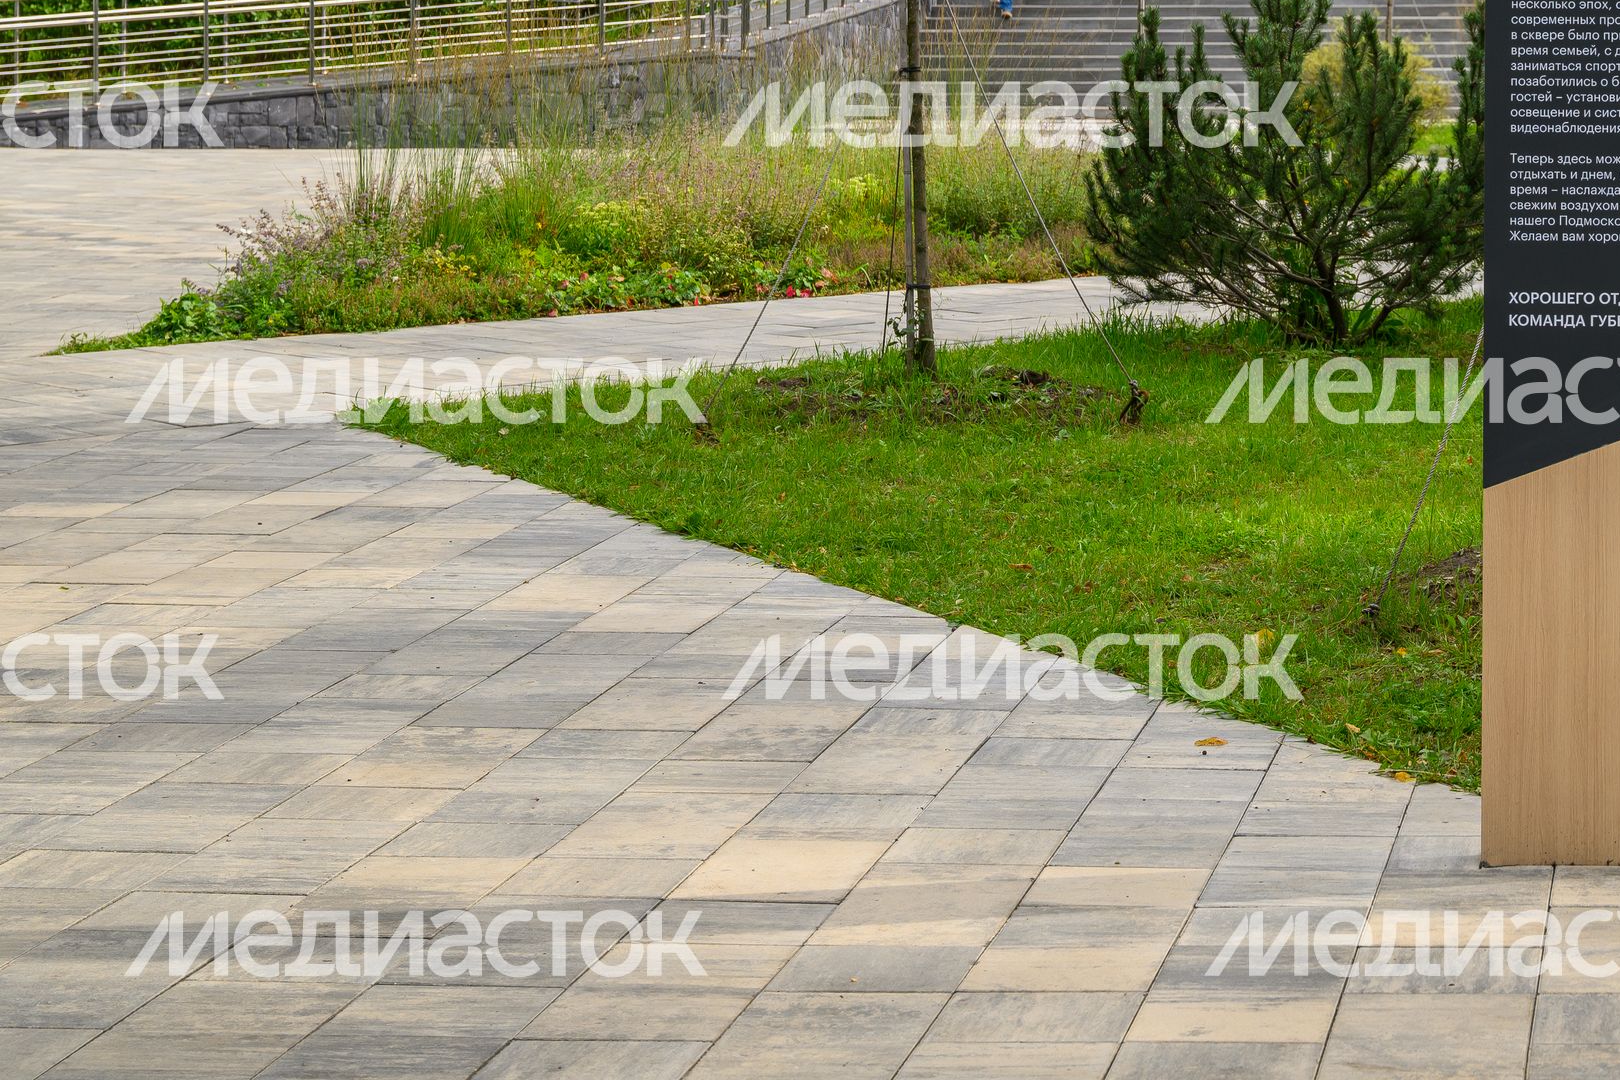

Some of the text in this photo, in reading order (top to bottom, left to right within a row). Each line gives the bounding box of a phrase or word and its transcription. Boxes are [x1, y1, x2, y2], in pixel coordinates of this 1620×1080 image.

[1511, 0, 1577, 10] несколько
[1578, 0, 1612, 12] эпох,
[1510, 15, 1596, 27] современных
[1510, 31, 1518, 40] в
[1520, 31, 1565, 43] сквере
[1567, 28, 1600, 41] было
[1510, 46, 1549, 58] время
[1551, 44, 1601, 57] семьей,
[1604, 47, 1613, 56] с
[1510, 62, 1582, 72] заниматься
[1510, 75, 1598, 87] позаботились
[1600, 78, 1609, 87] о
[1510, 90, 1553, 103] гостей
[1510, 108, 1581, 119] освещение
[1583, 109, 1591, 118] и
[1509, 152, 1555, 167] Теперь
[1556, 155, 1593, 166] здесь
[1509, 170, 1568, 181] отдыхать
[1570, 170, 1578, 180] и
[1580, 170, 1616, 182] днем,
[1509, 185, 1548, 197] время
[1509, 201, 1557, 211] свежим
[1560, 201, 1619, 214] воздухом
[1509, 216, 1556, 226] нашего
[1509, 230, 1559, 242] Желаем
[1561, 232, 1585, 242] вам
[1508, 291, 1596, 305] ХОРОШЕГО
[1508, 313, 1586, 329] КОМАНДА
